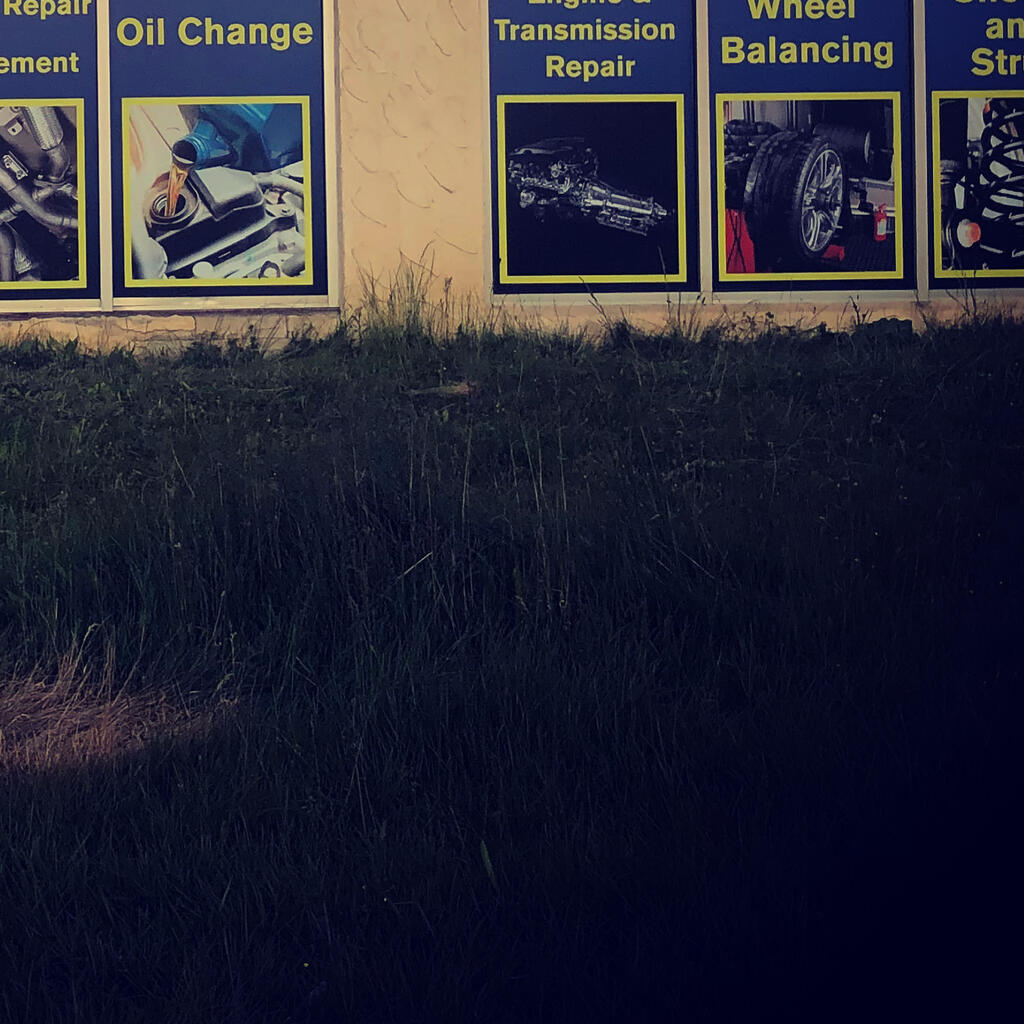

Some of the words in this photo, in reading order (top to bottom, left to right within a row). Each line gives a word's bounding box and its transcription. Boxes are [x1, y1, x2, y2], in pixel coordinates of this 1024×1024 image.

[116, 17, 165, 47] Oil
[177, 16, 313, 51] Change
[493, 18, 676, 41] Transmission
[721, 35, 894, 69] Balancing
[970, 47, 1024, 76] Str
[545, 54, 636, 83] Repair
